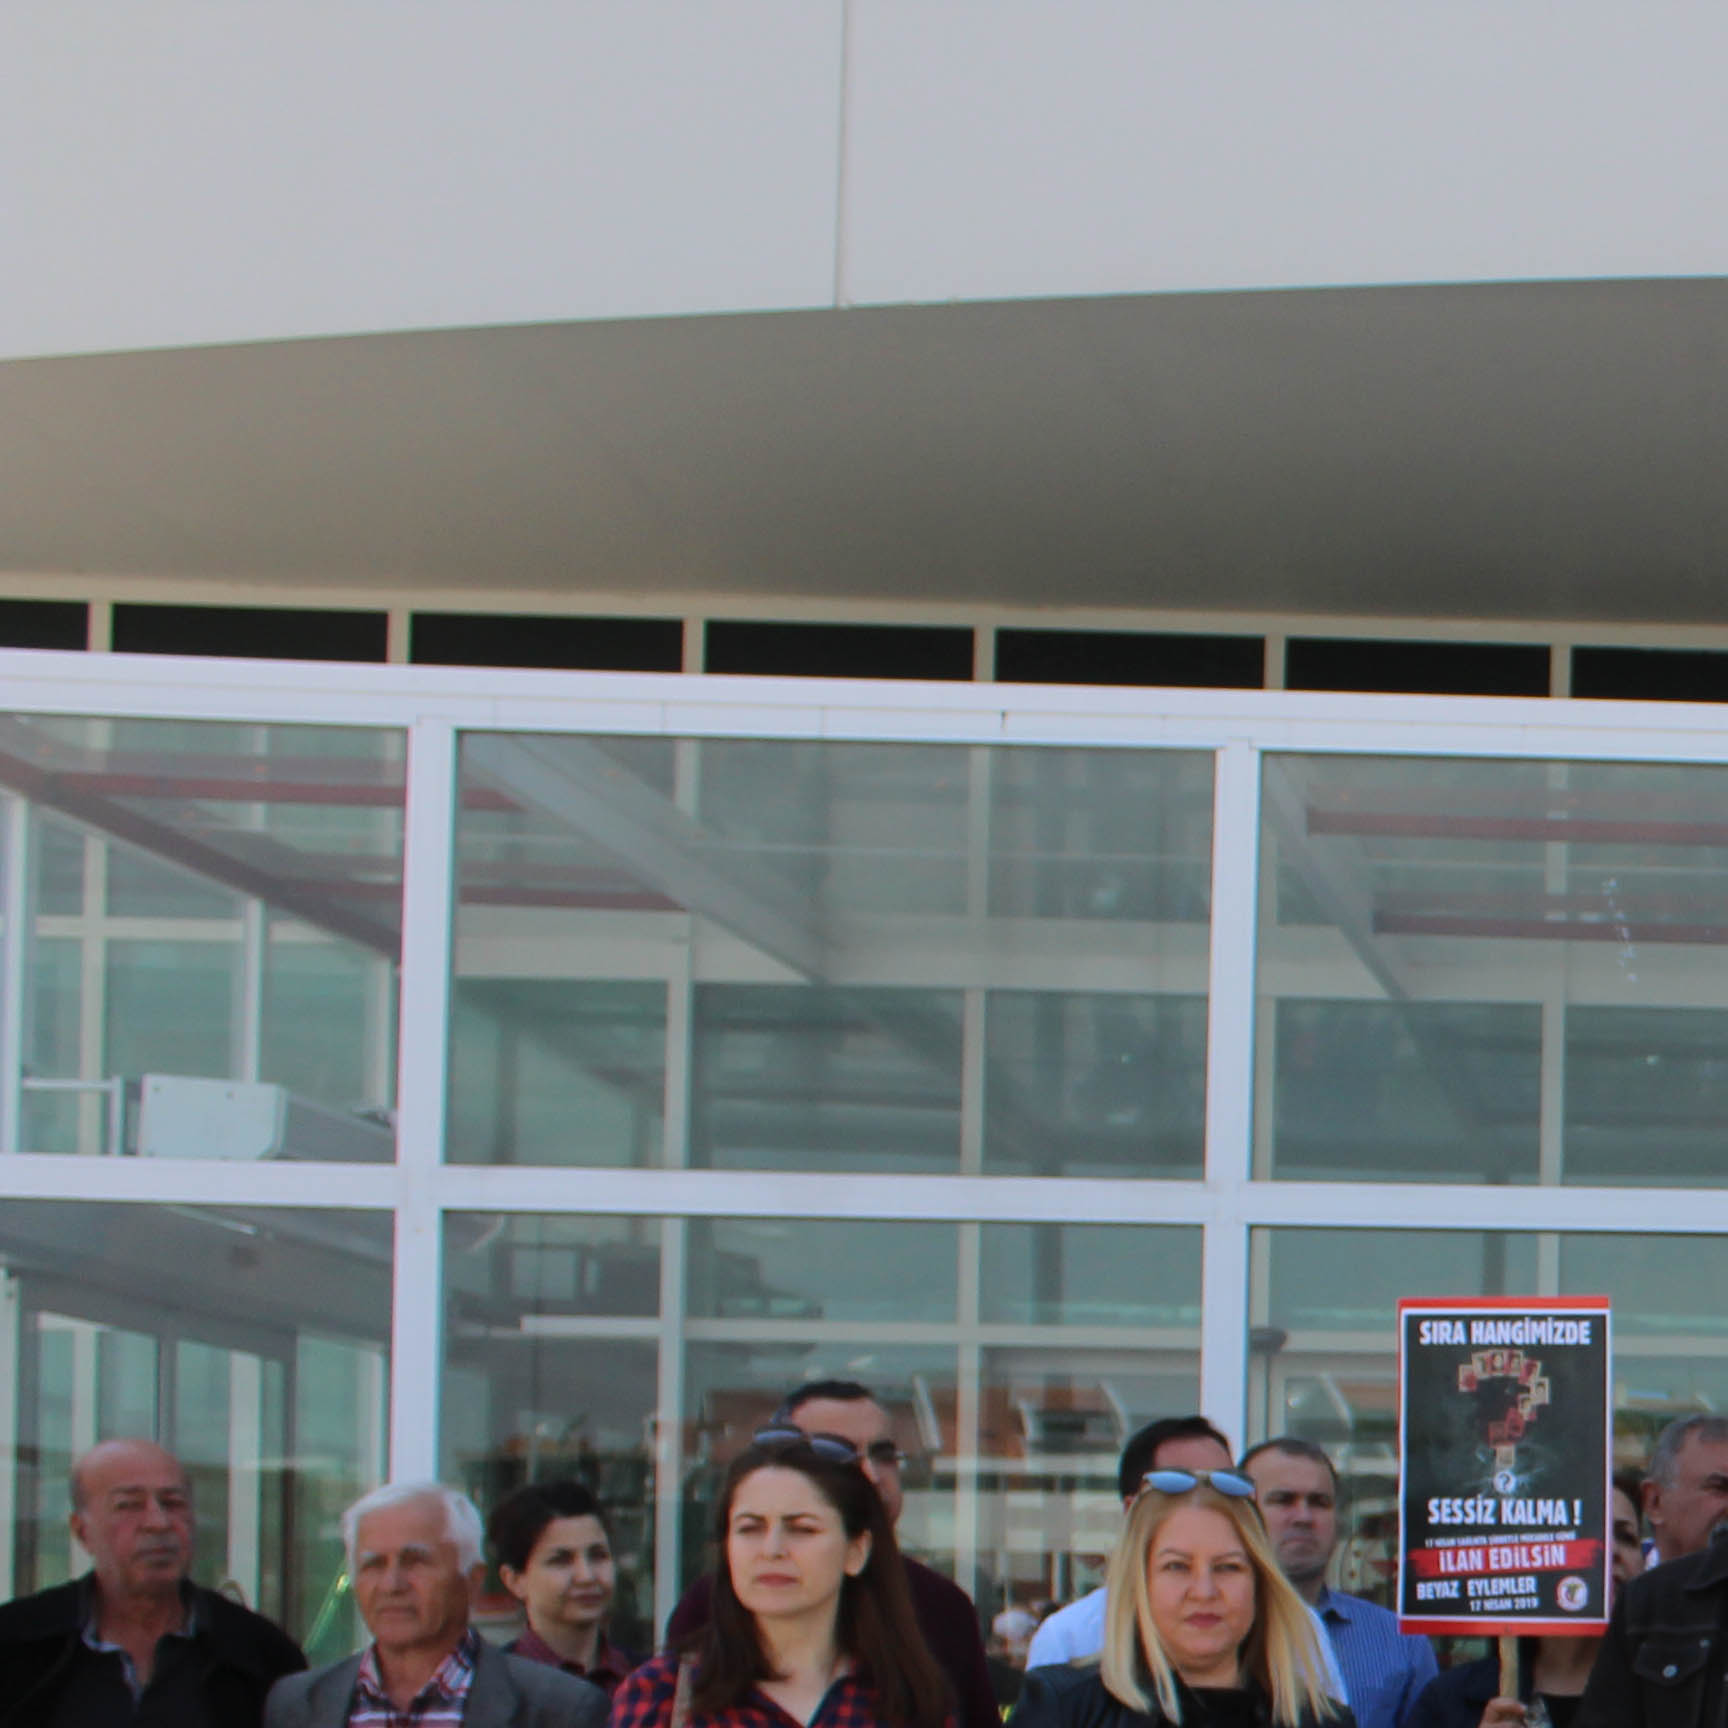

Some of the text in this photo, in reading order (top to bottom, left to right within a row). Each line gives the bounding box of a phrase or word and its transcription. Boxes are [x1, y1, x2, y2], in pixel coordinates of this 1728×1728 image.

[1419, 1316, 1592, 1345] SIRA HANGİMİZDE
[1428, 1496, 1497, 1526] SESSİZ
[1501, 1499, 1568, 1526] KALMA
[1439, 1543, 1567, 1573] İLAN EDİLSİN
[1416, 1576, 1538, 1600] BEYAZ EYLEMLER
[1483, 1598, 1512, 1612] NİSAN
